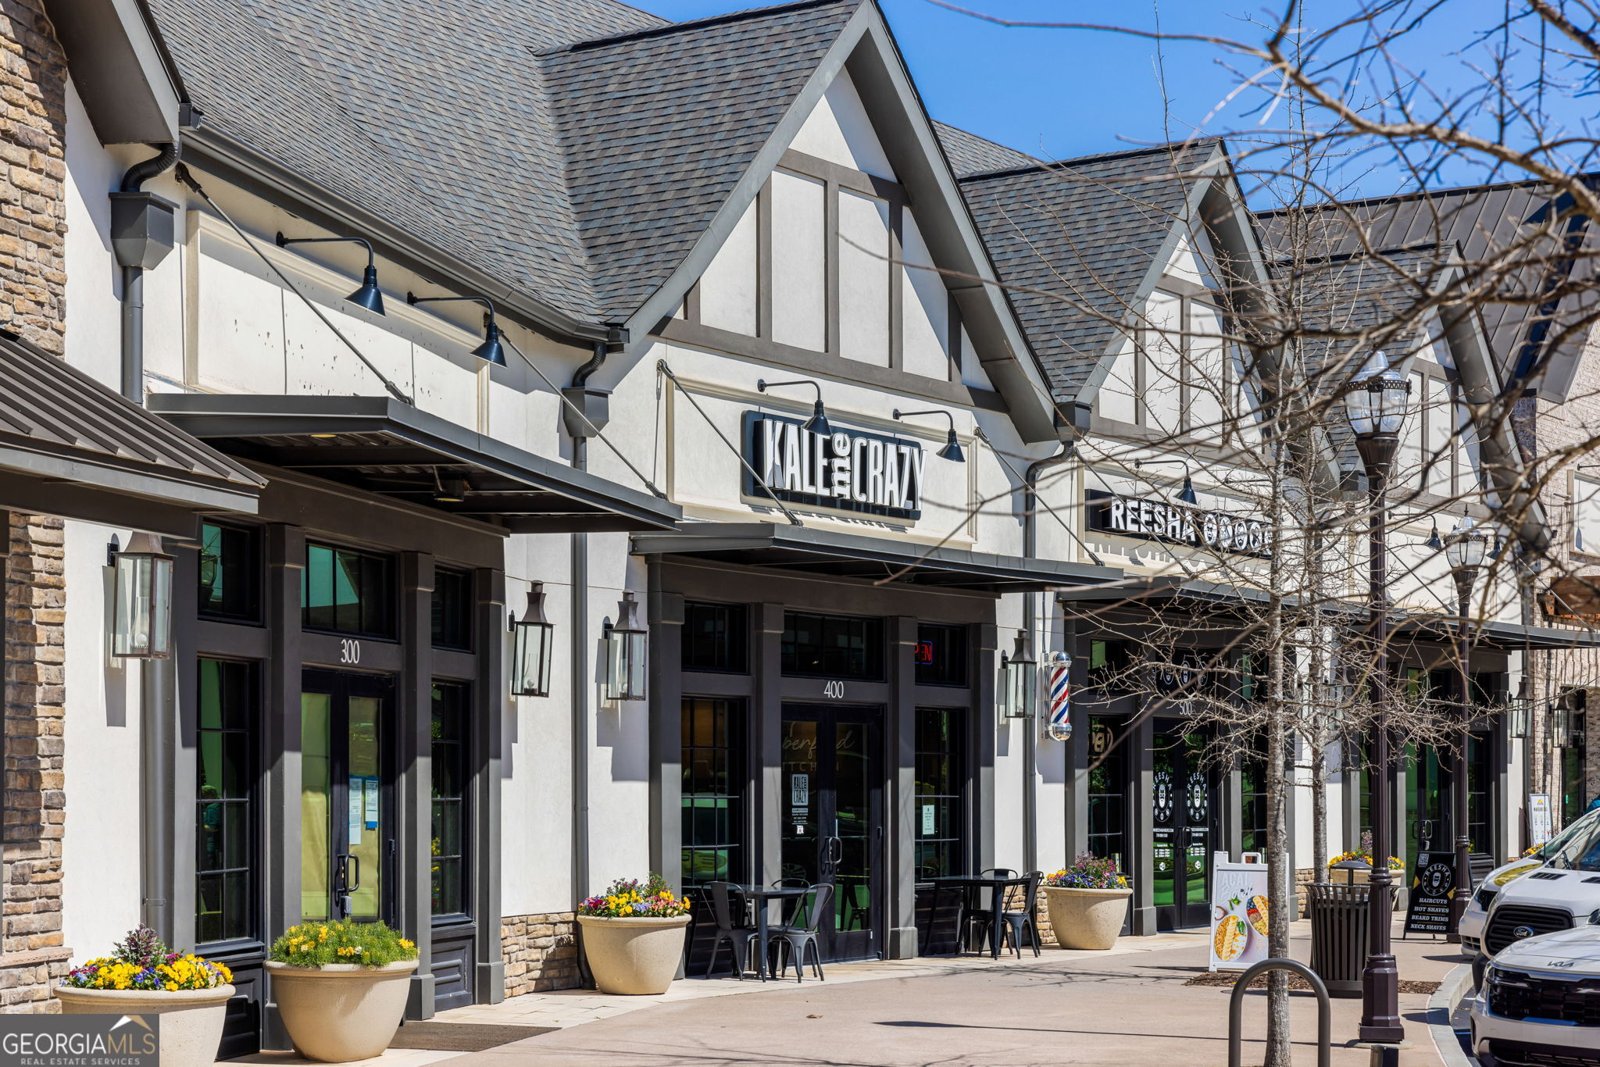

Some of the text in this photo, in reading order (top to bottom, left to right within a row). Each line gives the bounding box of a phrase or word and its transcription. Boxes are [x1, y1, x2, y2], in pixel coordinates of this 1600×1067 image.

[764, 419, 830, 496] KALE
[852, 437, 927, 510] CRAZY
[1112, 497, 1196, 542] REESHA
[341, 639, 360, 664] 300
[824, 681, 844, 699] 400
[1187, 772, 1206, 790] REESHA
[1425, 865, 1451, 876] REESHA
